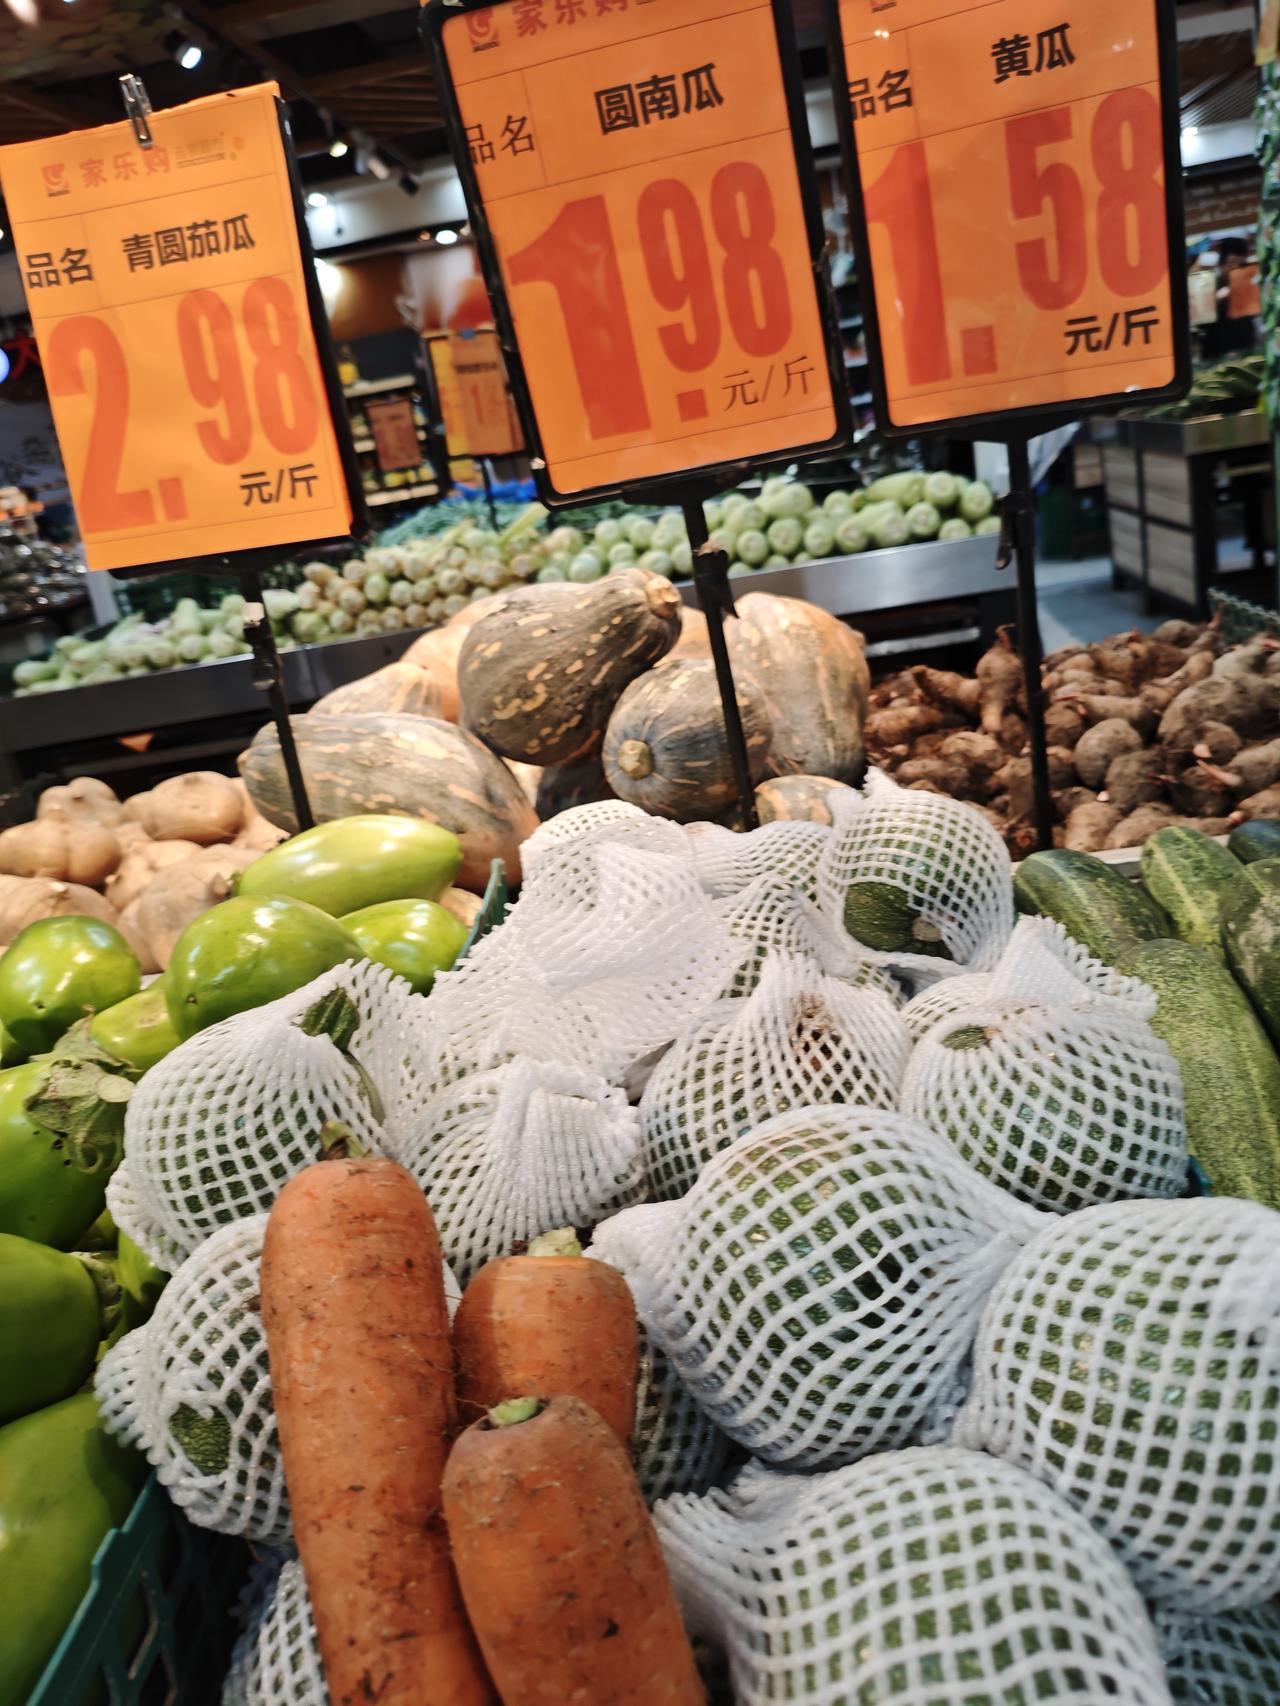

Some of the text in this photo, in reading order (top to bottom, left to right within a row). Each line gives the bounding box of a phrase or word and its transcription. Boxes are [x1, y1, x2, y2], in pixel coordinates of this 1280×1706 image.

[990, 22, 1076, 84] 黄瓜
[594, 62, 725, 136] 圆南瓜
[846, 69, 914, 120] 品名
[79, 146, 171, 189] 家乐购
[463, 114, 536, 167] 品名
[121, 213, 257, 273] 青圆茄瓜
[862, 87, 1169, 386] 1.58
[25, 247, 94, 288] 品名
[507, 161, 793, 441] 1.98
[1063, 305, 1160, 356] 元/斤
[47, 276, 320, 534] 2.98
[720, 355, 815, 412] 元/斤
[239, 462, 319, 507] 元/斤
